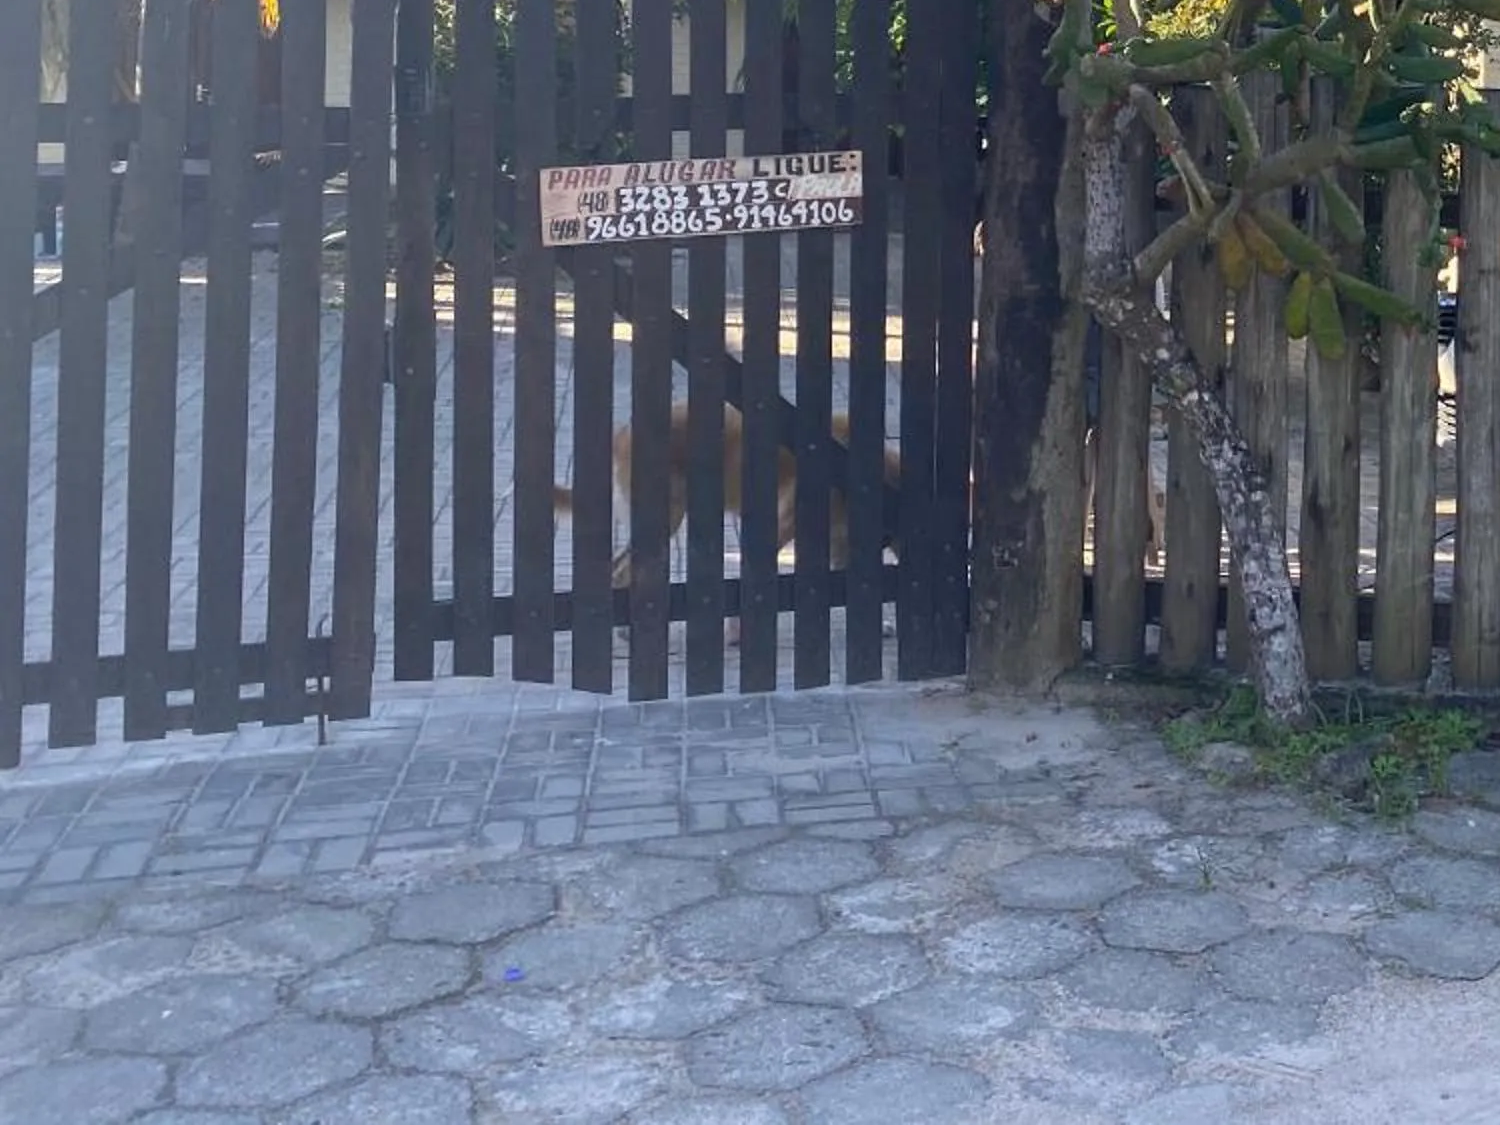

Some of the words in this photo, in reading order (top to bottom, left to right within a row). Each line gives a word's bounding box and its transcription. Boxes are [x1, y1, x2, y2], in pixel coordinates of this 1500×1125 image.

[549, 166, 612, 190] PARA
[624, 159, 737, 185] ALUGAR
[753, 154, 857, 178] LIGUE:
[619, 185, 689, 213] 3283
[698, 181, 768, 206] 1373
